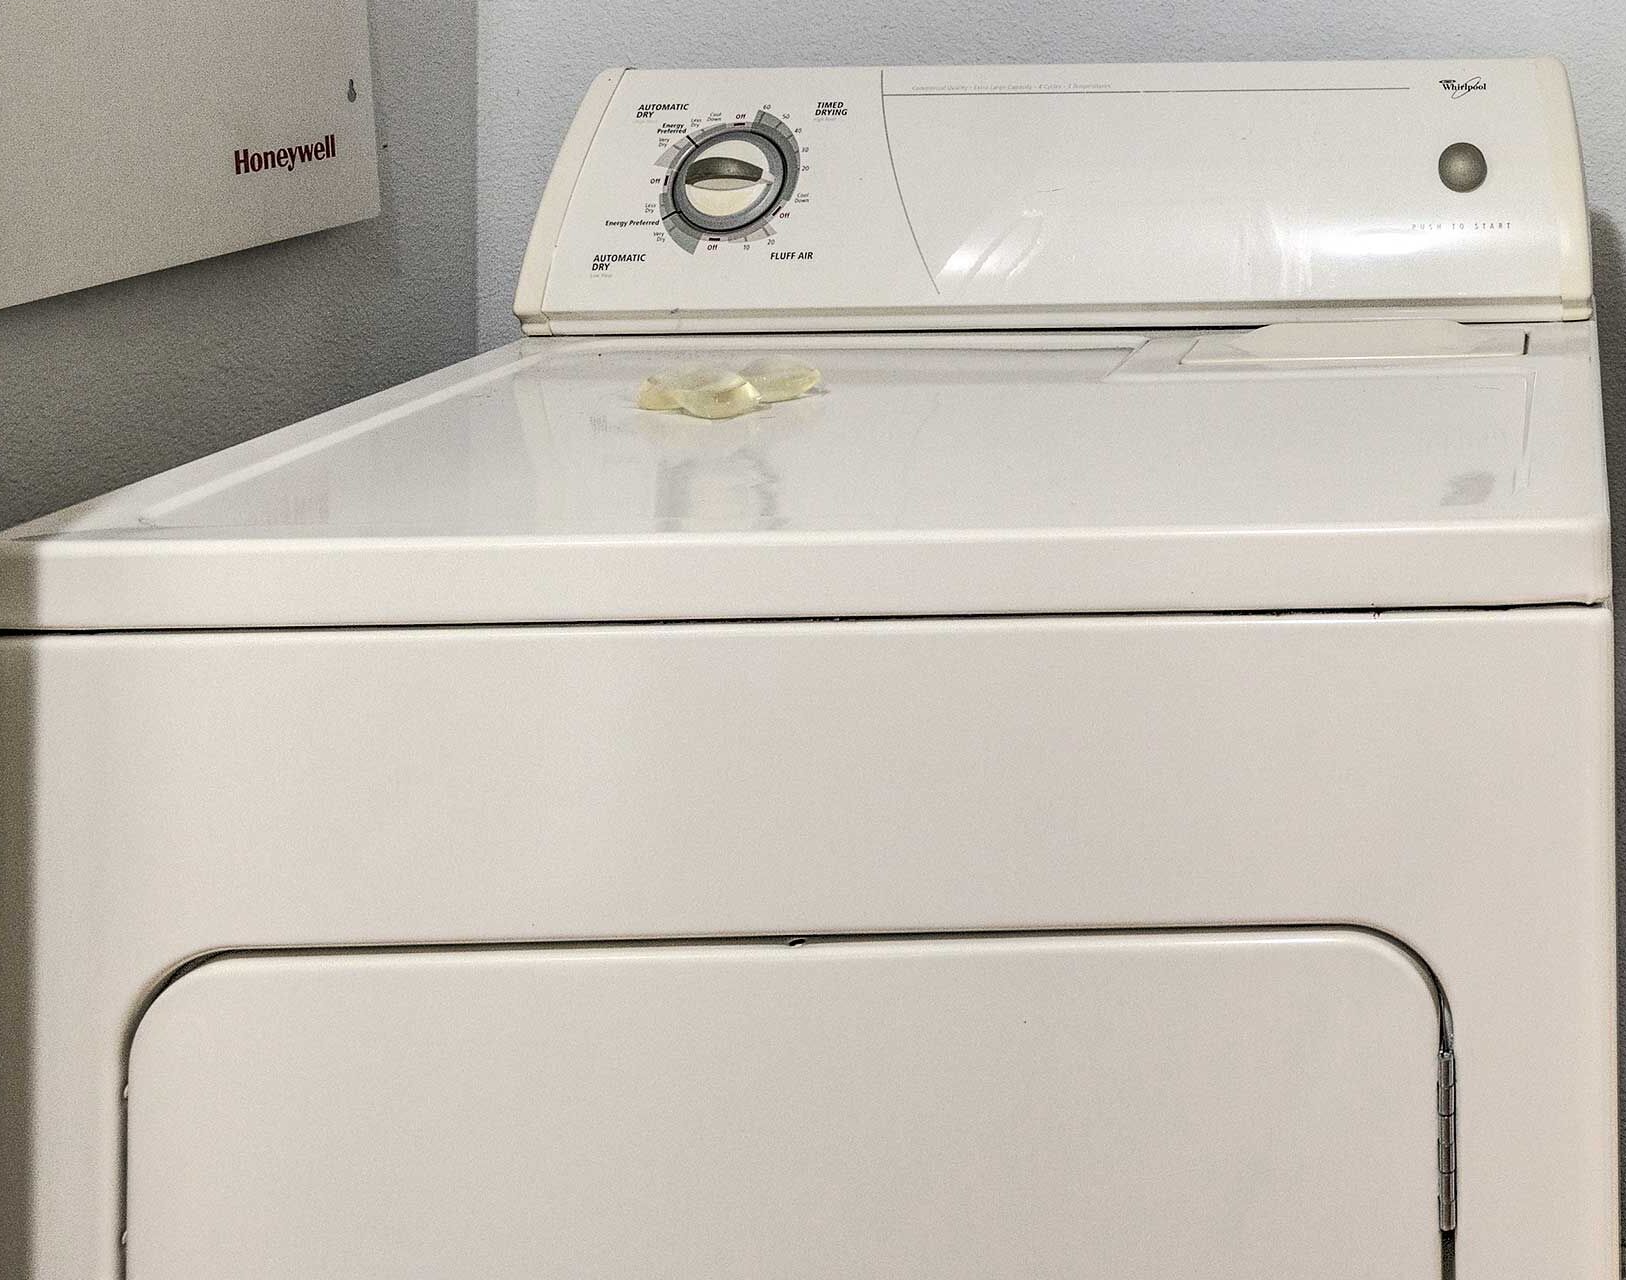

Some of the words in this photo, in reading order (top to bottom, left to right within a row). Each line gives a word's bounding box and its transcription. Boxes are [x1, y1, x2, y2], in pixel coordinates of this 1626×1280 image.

[1441, 79, 1487, 93] Whirlpool
[638, 103, 690, 111] AUTOMATIC
[817, 101, 844, 109] TIMED
[815, 108, 848, 116] DRYING
[234, 134, 336, 175] Honeywell
[650, 177, 661, 185] Off
[1474, 222, 1511, 230] START
[593, 253, 647, 262] AUTOMATIC
[770, 251, 796, 260] FLUFF
[797, 251, 814, 260] AIR
[591, 263, 610, 271] DRY
